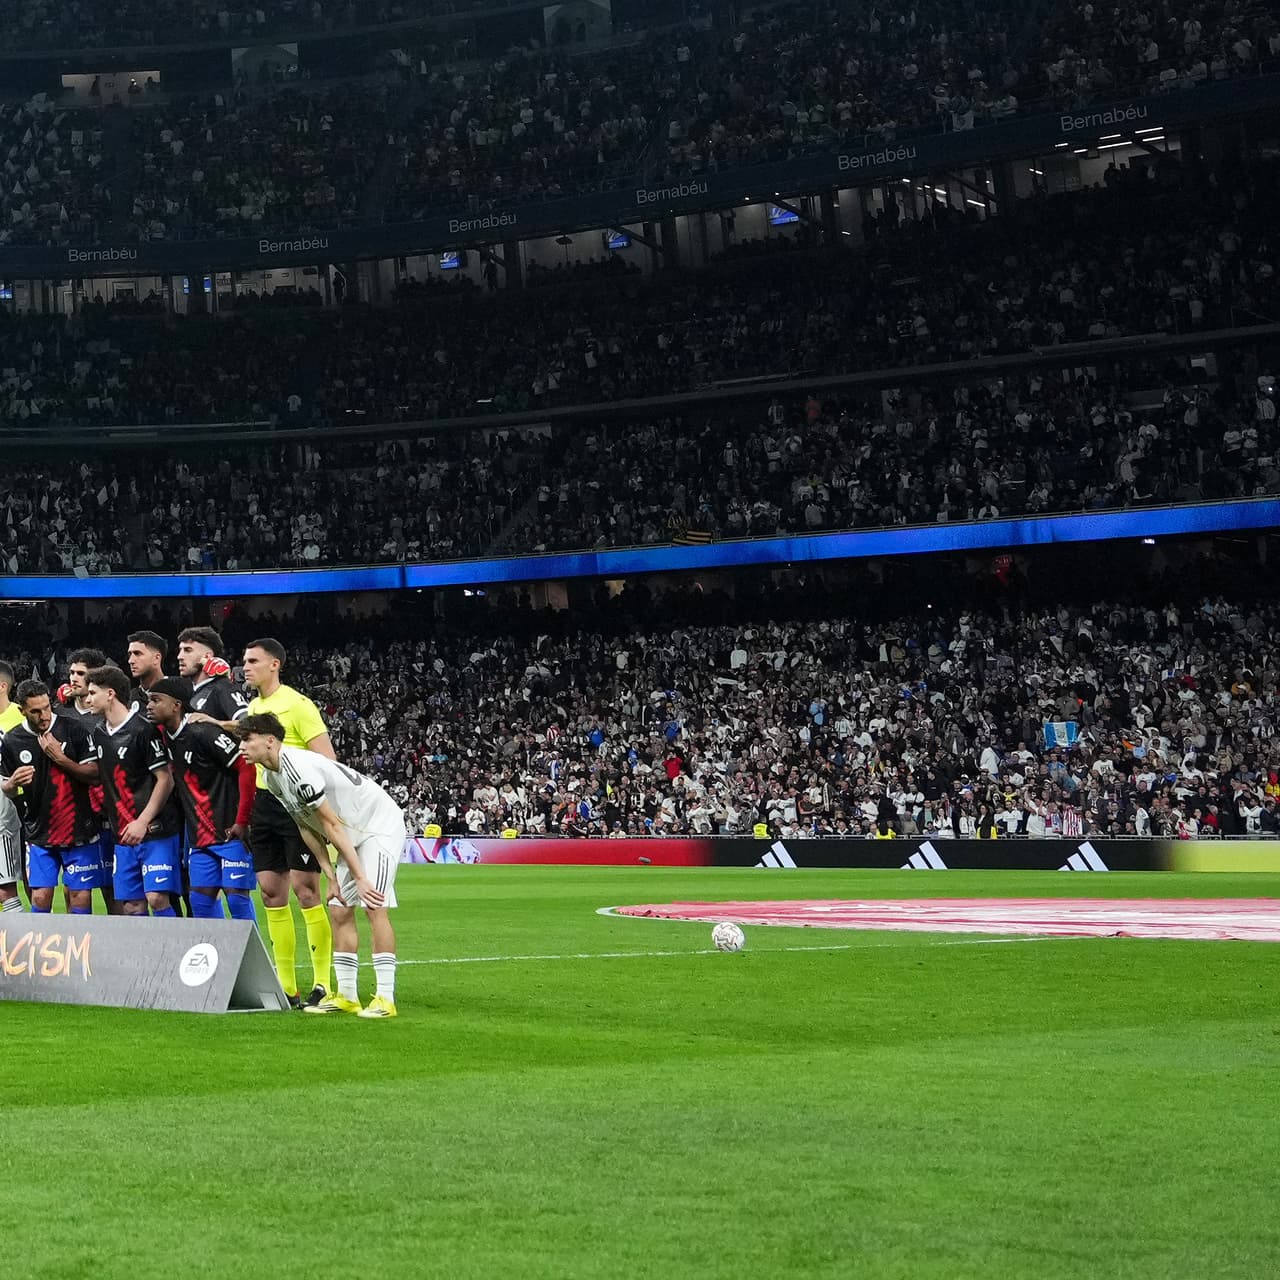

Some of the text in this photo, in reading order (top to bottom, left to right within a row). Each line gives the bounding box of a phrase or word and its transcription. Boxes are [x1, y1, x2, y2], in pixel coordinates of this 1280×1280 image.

[1060, 103, 1149, 133] Bernabéu
[838, 144, 918, 171] Bernabéu
[636, 179, 709, 205] Bernabéu
[448, 211, 518, 234] Bernabéu
[68, 246, 138, 264] Bernabéu
[259, 236, 329, 256] Bernabéu
[214, 733, 232, 749] VS
[188, 952, 210, 967] EA
